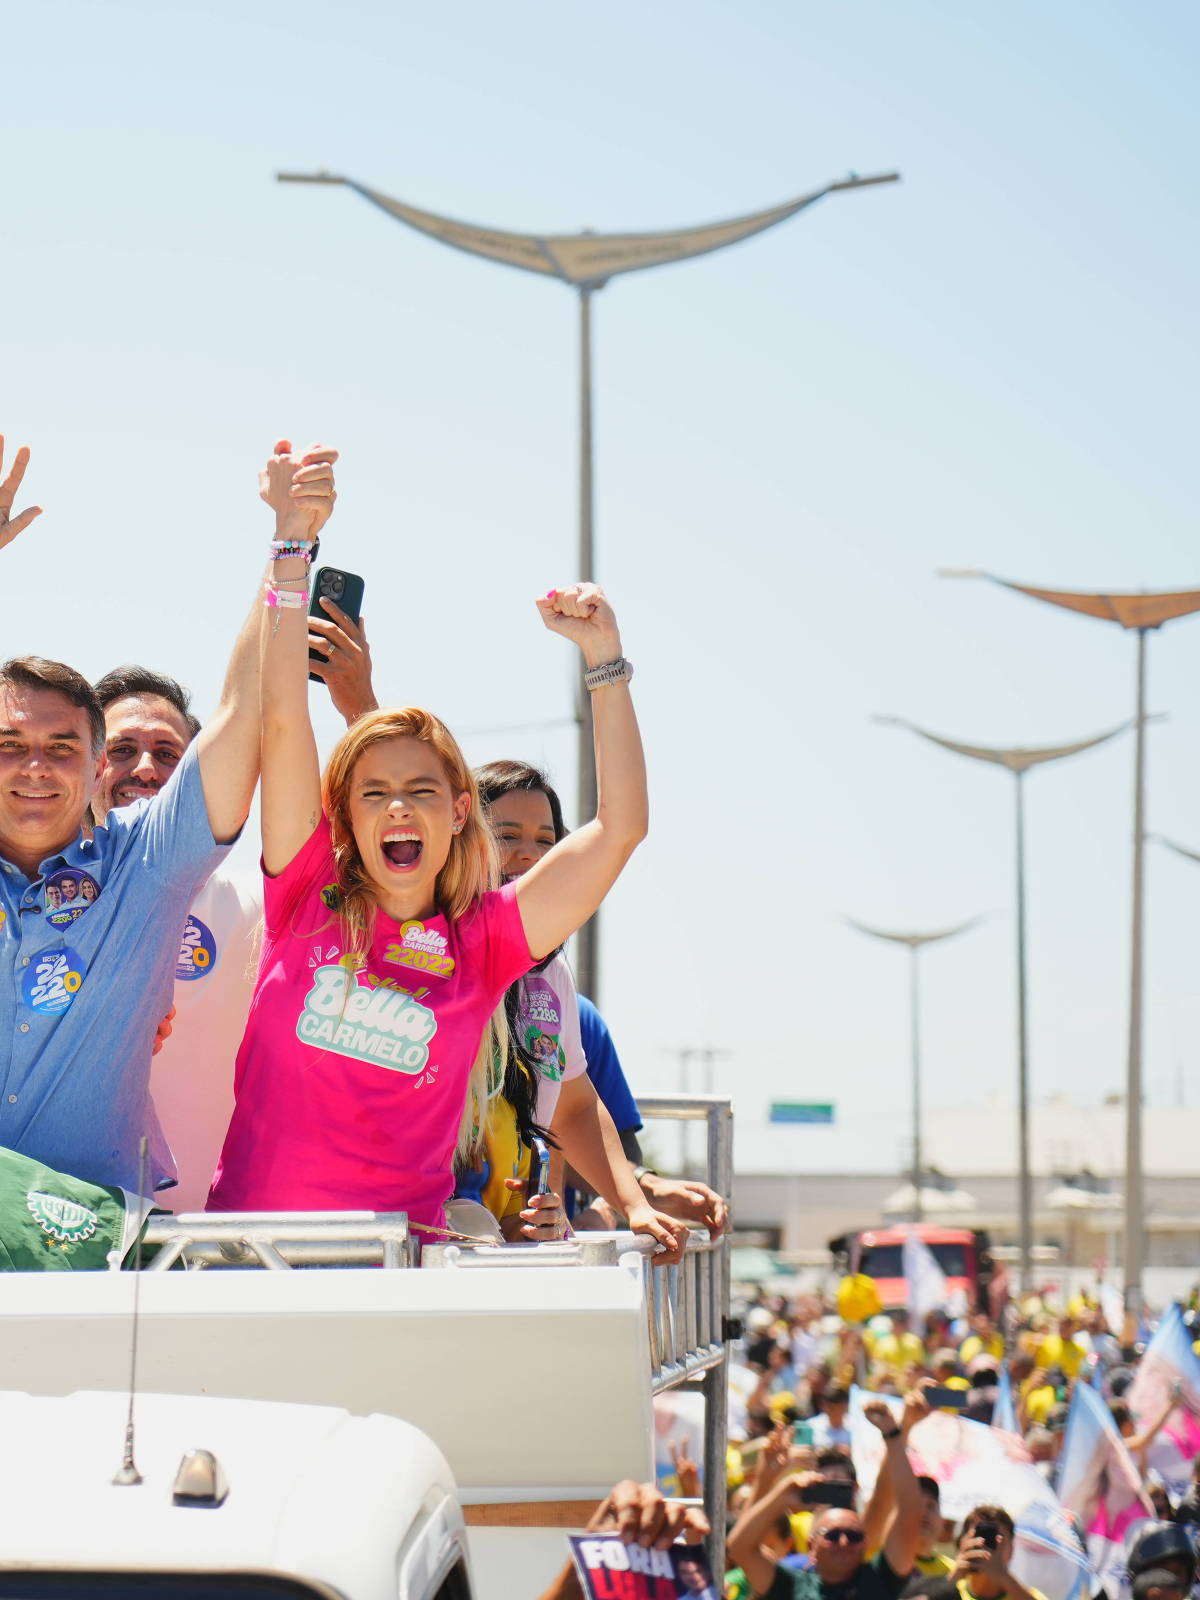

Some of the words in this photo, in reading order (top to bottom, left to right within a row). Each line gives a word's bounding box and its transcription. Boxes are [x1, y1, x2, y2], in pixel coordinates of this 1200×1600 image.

[402, 940, 446, 956] CARMELO
[404, 926, 448, 948] Bella
[385, 944, 456, 976] 22022
[308, 968, 434, 1042] Bella
[300, 1014, 425, 1067] CARMELO
[580, 1540, 676, 1580] FORA
